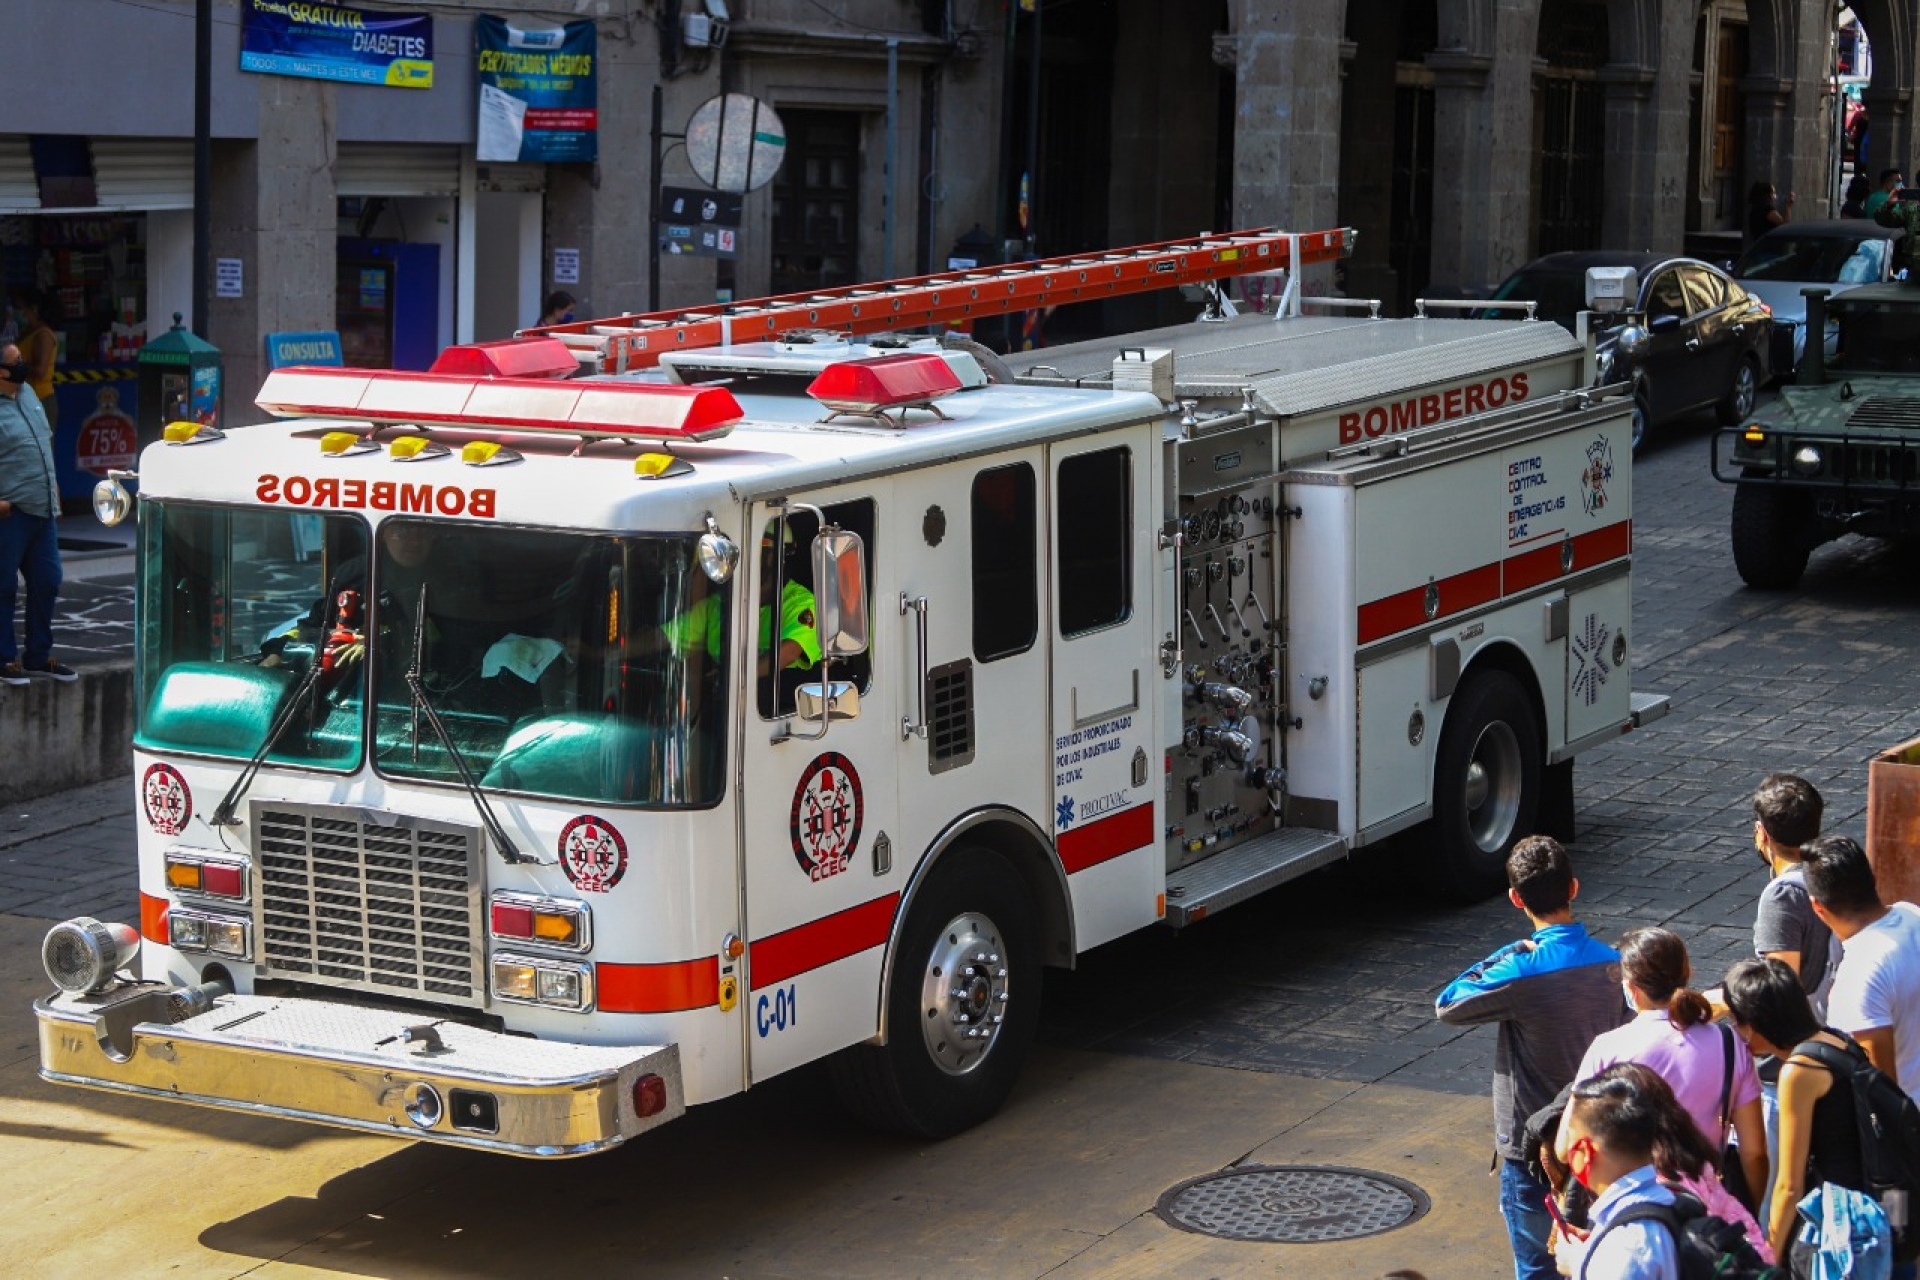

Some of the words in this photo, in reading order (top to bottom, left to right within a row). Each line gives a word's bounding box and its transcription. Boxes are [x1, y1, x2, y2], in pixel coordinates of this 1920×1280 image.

[288, 2, 366, 30] GRATUITA
[352, 31, 425, 58] DIABETES
[246, 56, 277, 70] TODOS
[293, 62, 328, 75] MARTES
[339, 67, 360, 78] ESTE
[362, 69, 377, 80] MES
[479, 49, 547, 75] CERTIFICADOS
[279, 341, 335, 361] CONSULTA
[1339, 372, 1529, 445] BOMBEROS
[90, 428, 126, 454] 75%
[1509, 456, 1542, 476] CENTRO
[1509, 472, 1547, 493] CONTROL
[1513, 494, 1523, 506] DE
[1056, 732, 1082, 750] SERVICIO
[1084, 716, 1132, 740] PROPORCIONADO
[1056, 751, 1069, 768] POR
[1070, 750, 1081, 764] LOS
[1083, 738, 1120, 760] INDUSTRIALES
[1056, 773, 1064, 786] DE
[1066, 768, 1082, 783] CIVAC
[1080, 789, 1128, 817] PROCIVAC
[811, 855, 847, 882] CCEC
[576, 879, 609, 893] CCEC
[757, 984, 795, 1037] C-01
